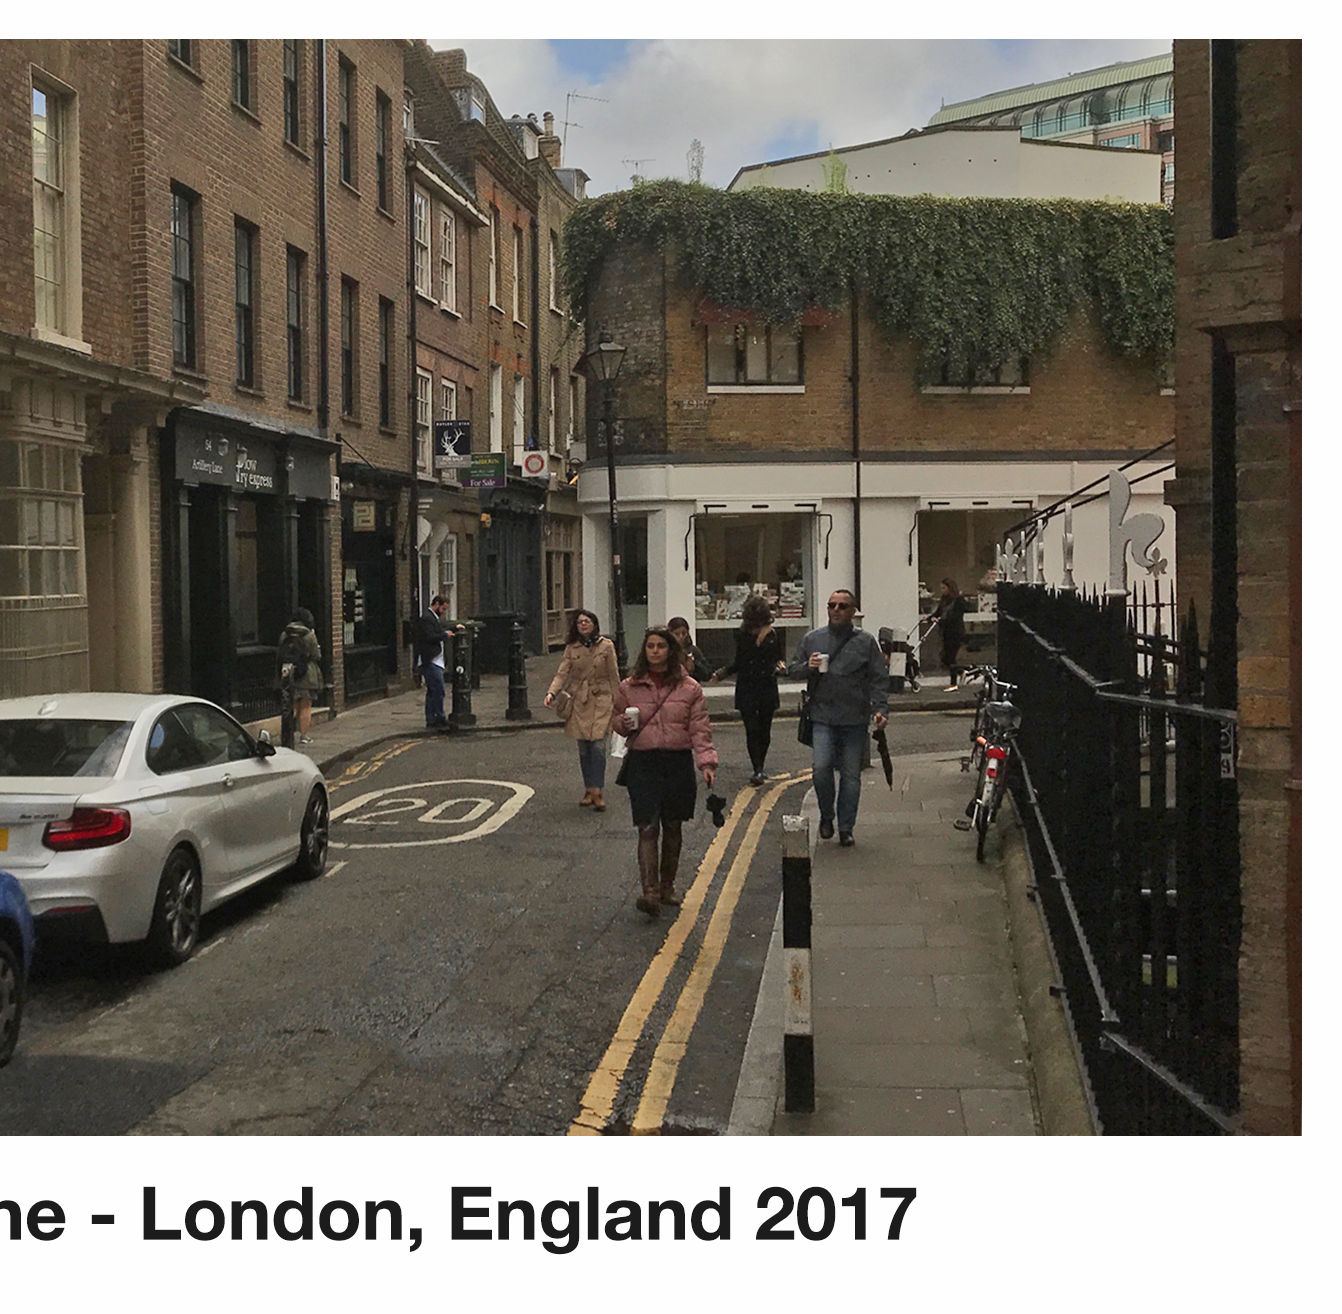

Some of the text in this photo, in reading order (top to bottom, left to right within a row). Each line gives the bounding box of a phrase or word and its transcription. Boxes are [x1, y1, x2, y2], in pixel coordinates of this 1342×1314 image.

[192, 459, 224, 474] Artillery Lane
[248, 473, 273, 490] express
[470, 479, 496, 488] For Sale
[342, 798, 495, 824] 20
